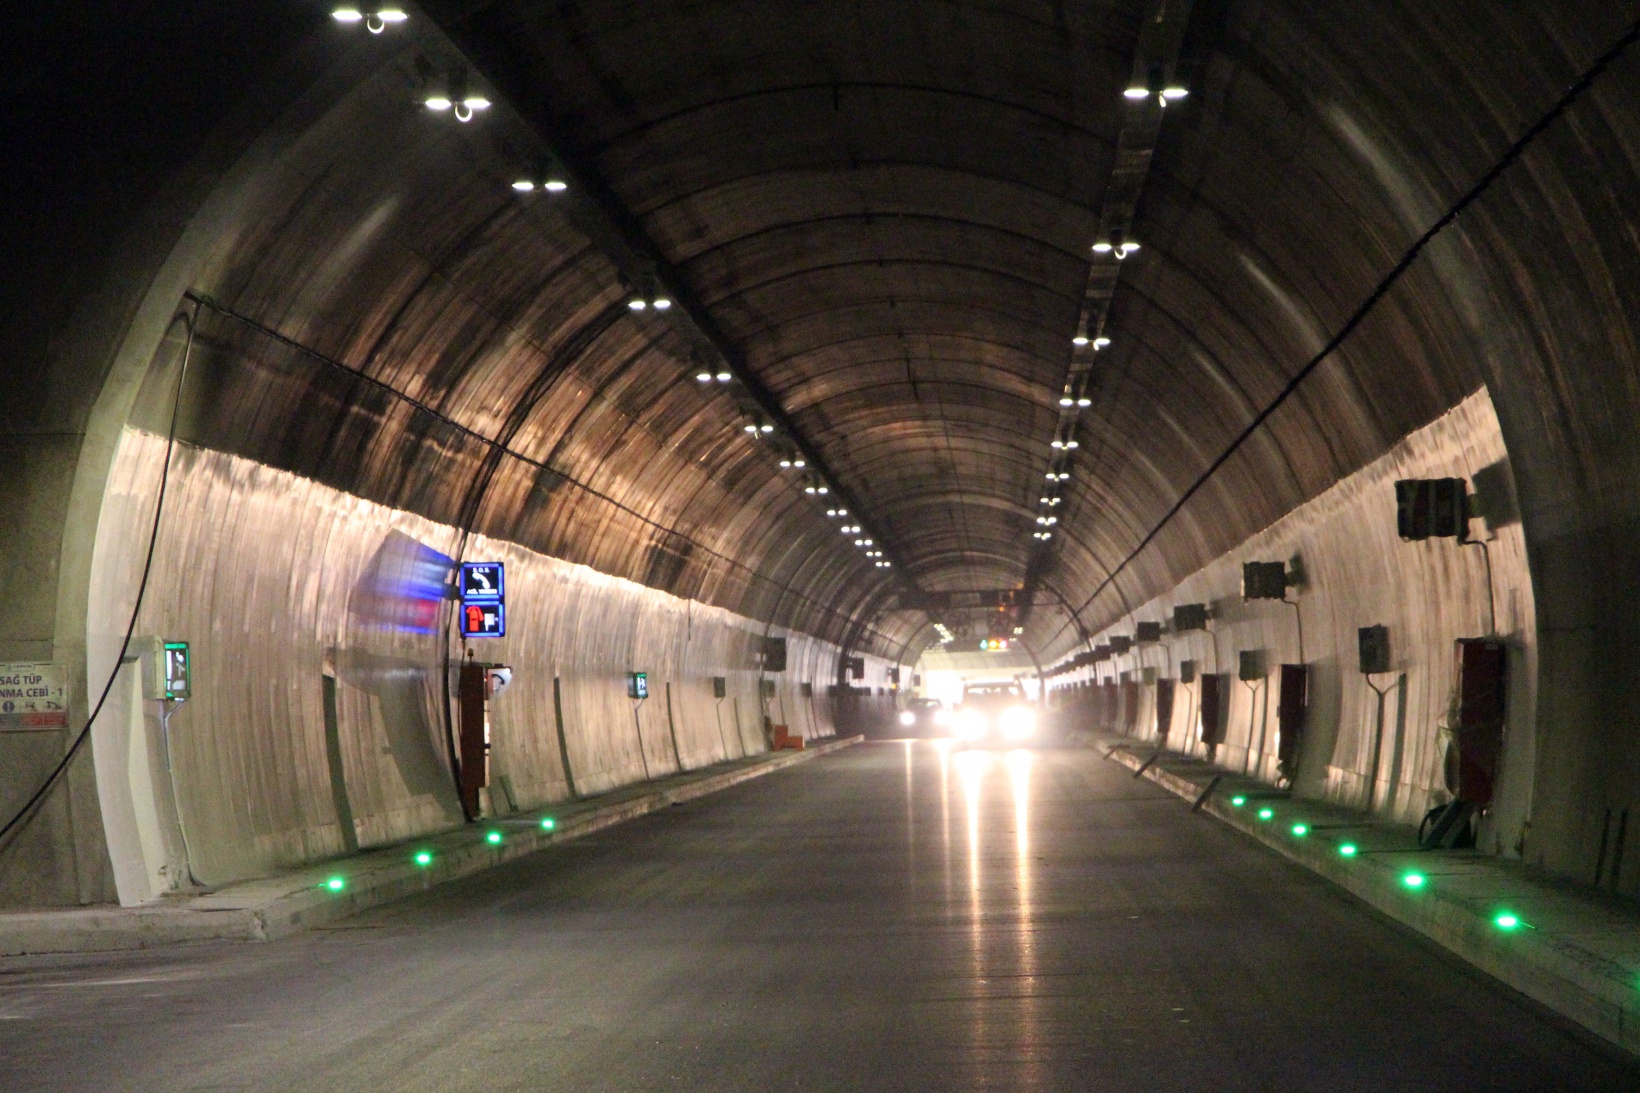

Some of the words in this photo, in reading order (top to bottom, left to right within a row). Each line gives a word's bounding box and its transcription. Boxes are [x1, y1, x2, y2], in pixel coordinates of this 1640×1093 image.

[23, 673, 42, 684] TÜP
[26, 686, 48, 697] CEBİ
[58, 688, 62, 696] 1
